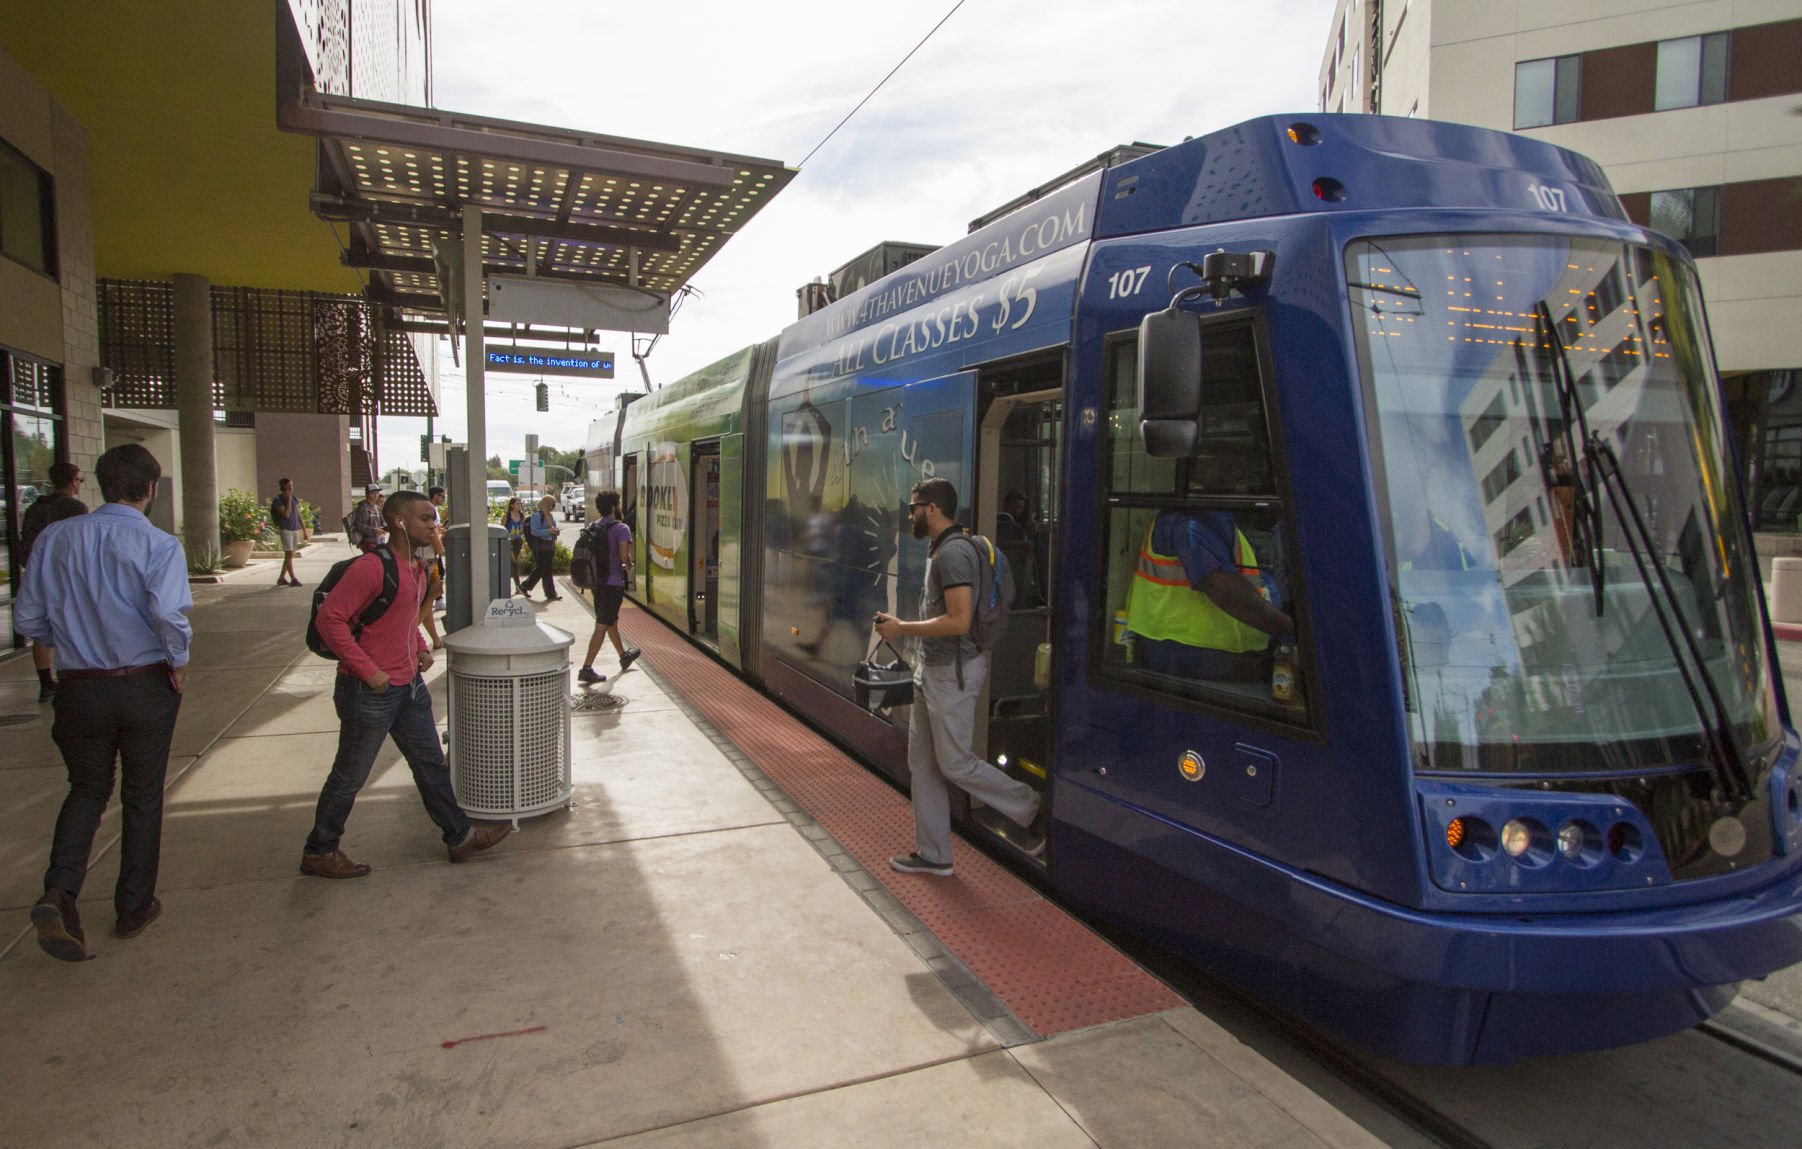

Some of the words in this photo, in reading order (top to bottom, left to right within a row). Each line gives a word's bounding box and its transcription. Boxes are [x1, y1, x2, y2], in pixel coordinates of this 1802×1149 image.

[1528, 184, 1567, 213] 107
[826, 201, 1085, 338] WWW.4THAVENUEYOGA.COM
[1108, 265, 1152, 300] 107
[832, 338, 865, 378] ALL
[872, 295, 981, 365] CLASSES
[992, 263, 1047, 336] $5
[489, 352, 510, 363] Fact
[529, 355, 544, 365] the
[546, 357, 589, 368] invention
[591, 360, 600, 369] of
